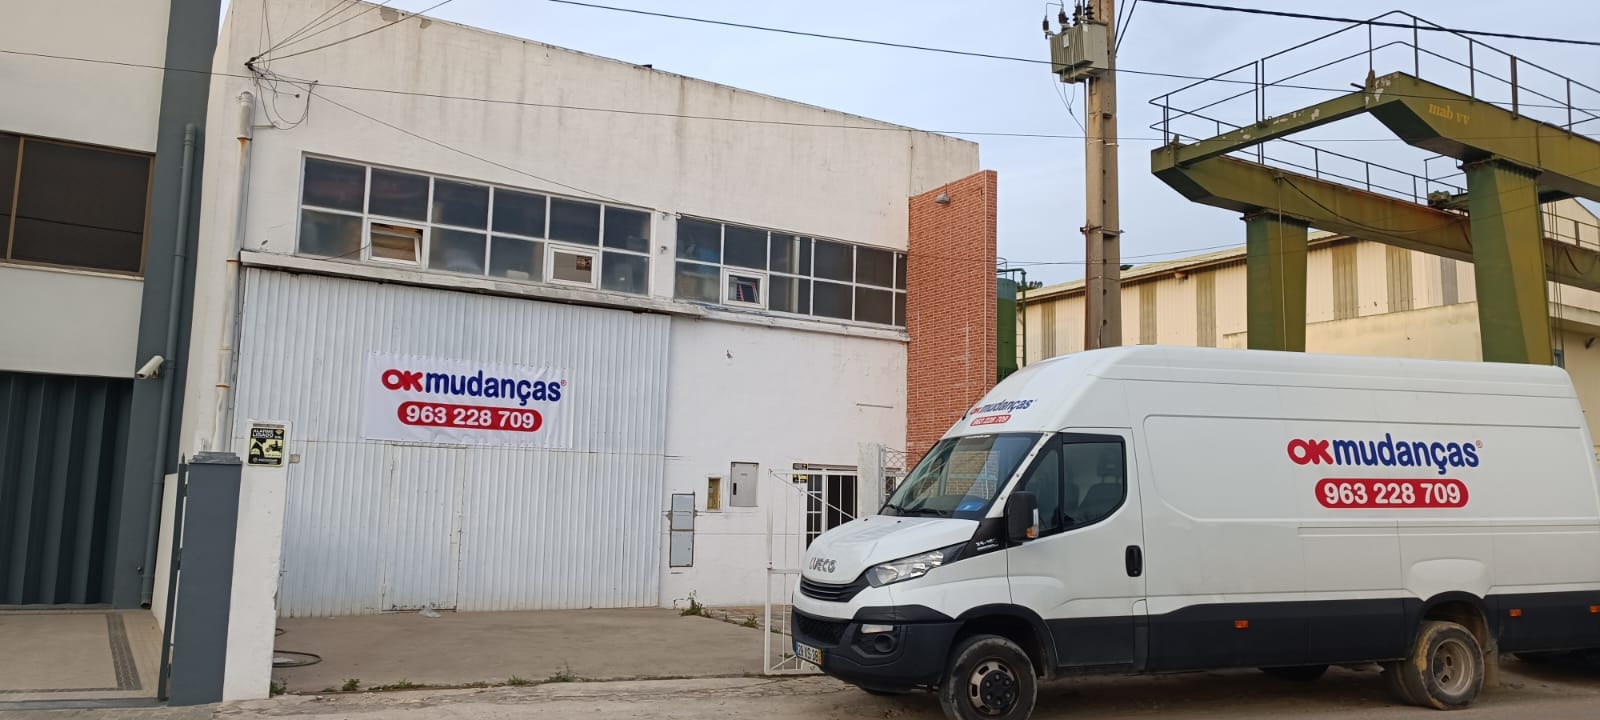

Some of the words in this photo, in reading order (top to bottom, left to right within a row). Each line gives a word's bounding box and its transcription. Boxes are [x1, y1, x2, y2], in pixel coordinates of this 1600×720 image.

[405, 405, 447, 424] 963
[453, 407, 492, 427] 228
[498, 410, 535, 429] 709
[1324, 482, 1368, 505] 963
[1373, 482, 1415, 505] 228
[1420, 482, 1461, 505] 709
[809, 557, 837, 573] IVECO
